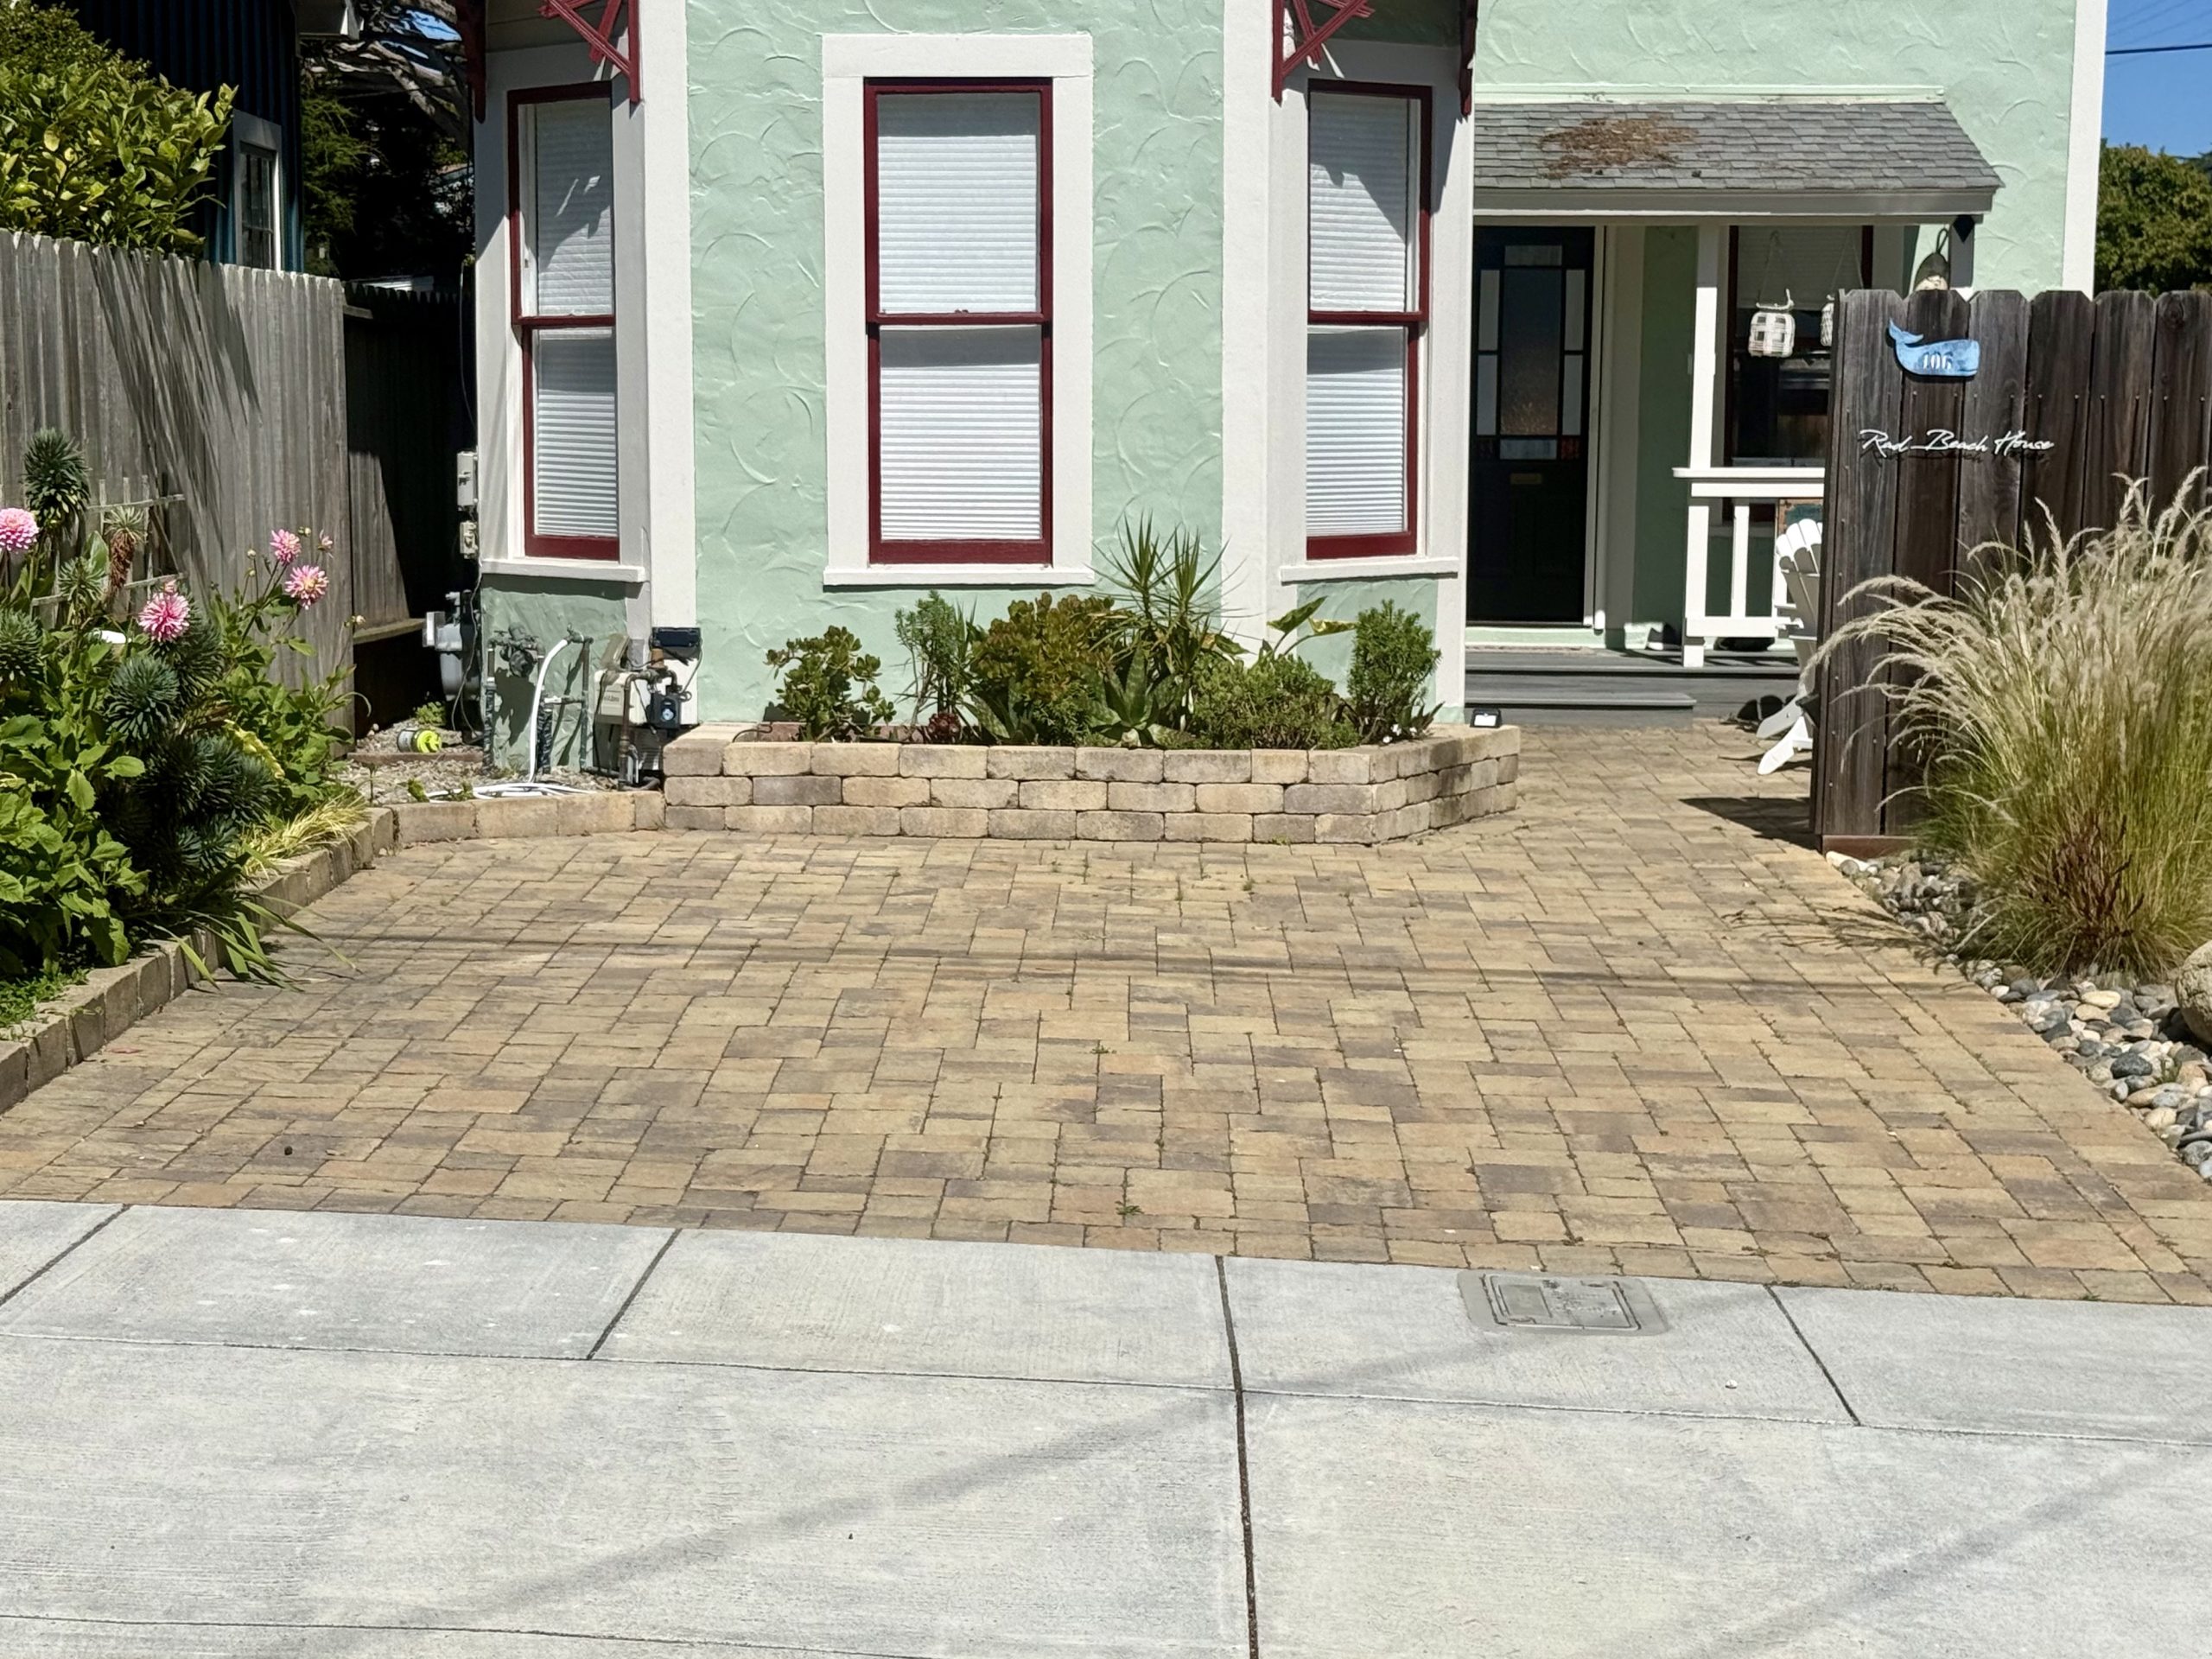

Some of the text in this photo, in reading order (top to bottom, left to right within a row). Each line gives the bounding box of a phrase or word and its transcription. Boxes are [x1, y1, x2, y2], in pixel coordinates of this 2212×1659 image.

[1923, 351, 1954, 370] 106
[1910, 429, 1989, 452] Beach
[1994, 429, 2055, 456] House
